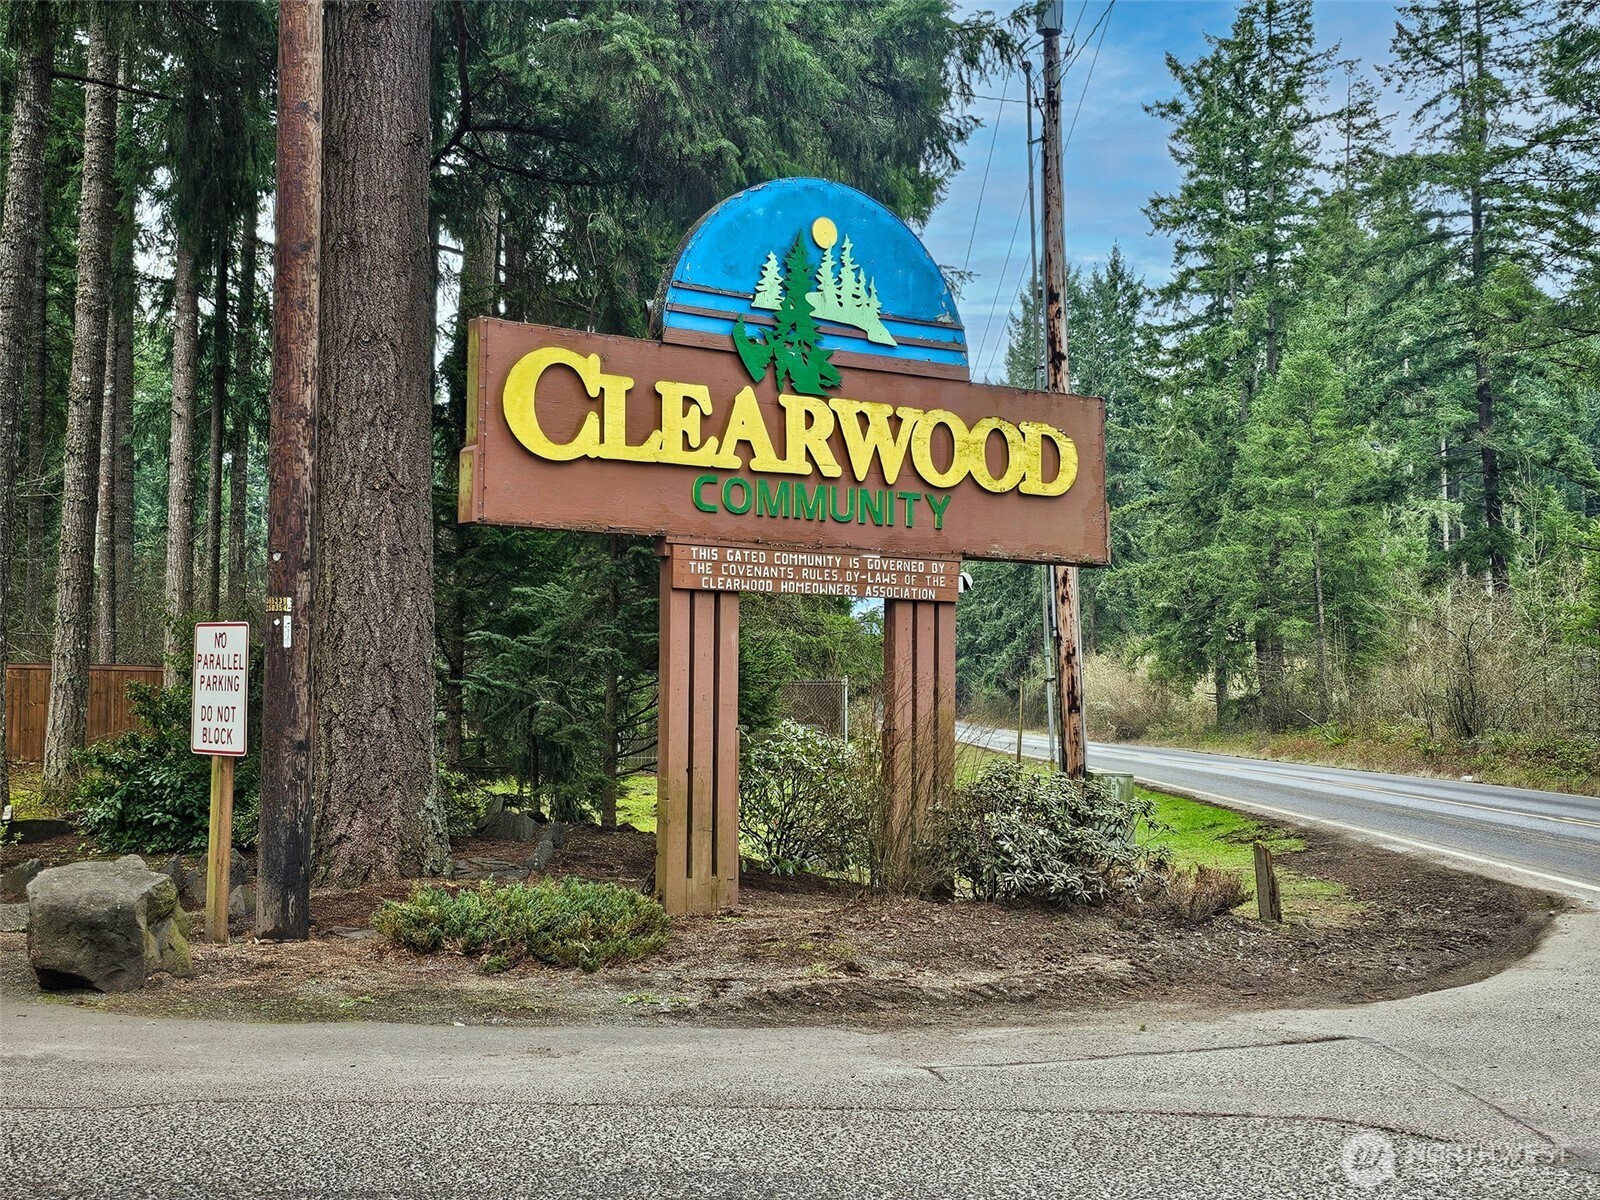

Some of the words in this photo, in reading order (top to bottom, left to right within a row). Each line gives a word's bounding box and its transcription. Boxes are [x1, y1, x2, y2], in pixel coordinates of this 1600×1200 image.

[503, 347, 1077, 496] CLEARWOOD
[692, 474, 951, 530] COMMUNITY
[691, 547, 719, 560] THIS
[726, 549, 766, 563] GATED
[774, 552, 841, 567] COMMUNITY
[849, 557, 859, 569] IS
[867, 558, 925, 573] GOVERNED
[931, 562, 945, 574] BY
[690, 561, 713, 574] THE
[846, 571, 897, 585] BY-LAWS
[904, 574, 917, 585] OF
[926, 575, 946, 587] THE
[701, 576, 773, 592] CLEARWOOD
[780, 581, 858, 596] HOMEOWNERS
[865, 588, 936, 600] ASSOCIATION
[214, 631, 227, 649] NO
[197, 653, 244, 670] PARALLEL
[200, 675, 240, 692] PARKING
[201, 705, 213, 722] DO
[217, 705, 236, 723] NOT
[202, 727, 233, 745] BLOCK
